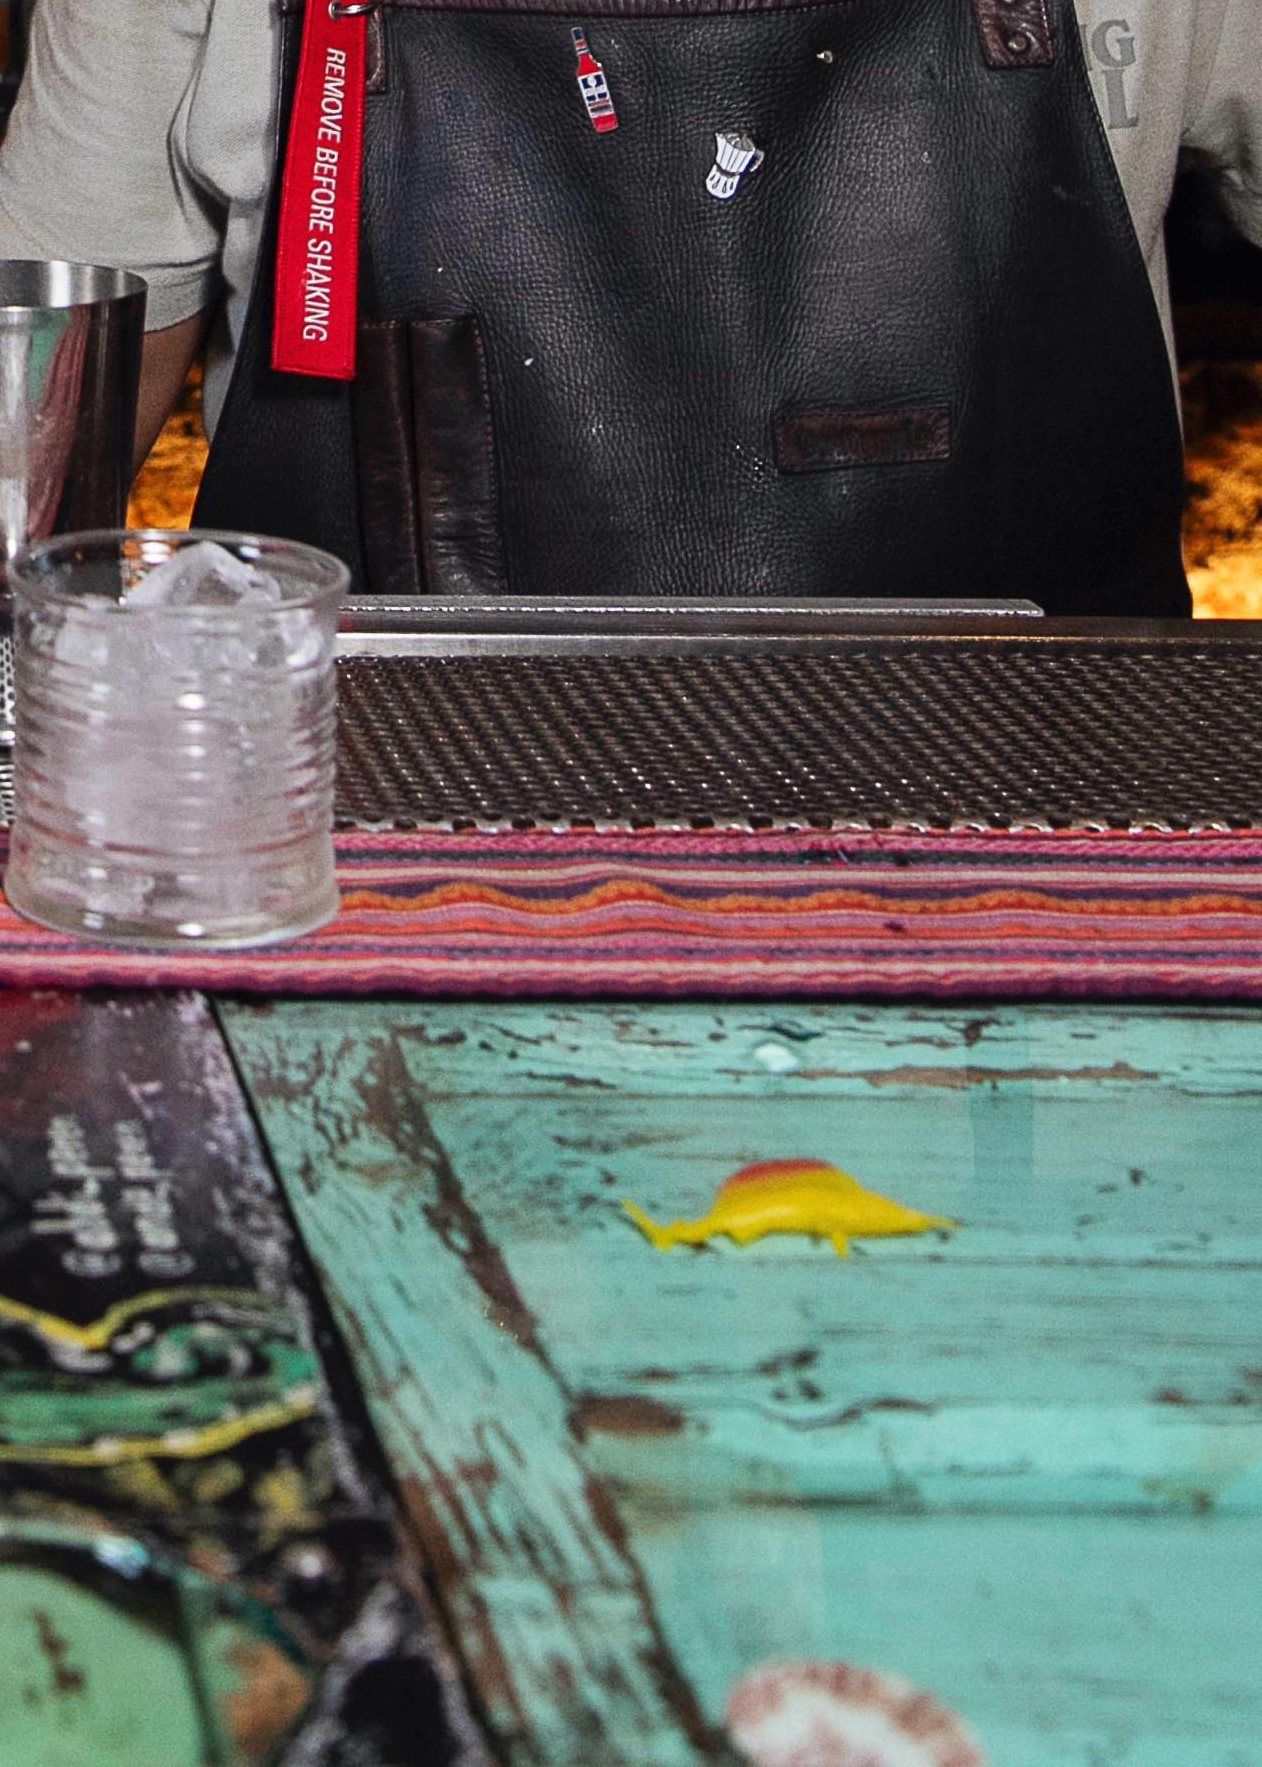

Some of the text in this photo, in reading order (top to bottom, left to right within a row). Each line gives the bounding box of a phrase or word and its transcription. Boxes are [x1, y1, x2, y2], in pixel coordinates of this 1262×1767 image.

[302, 47, 347, 342] REMOVE BEFORE SHAKING
